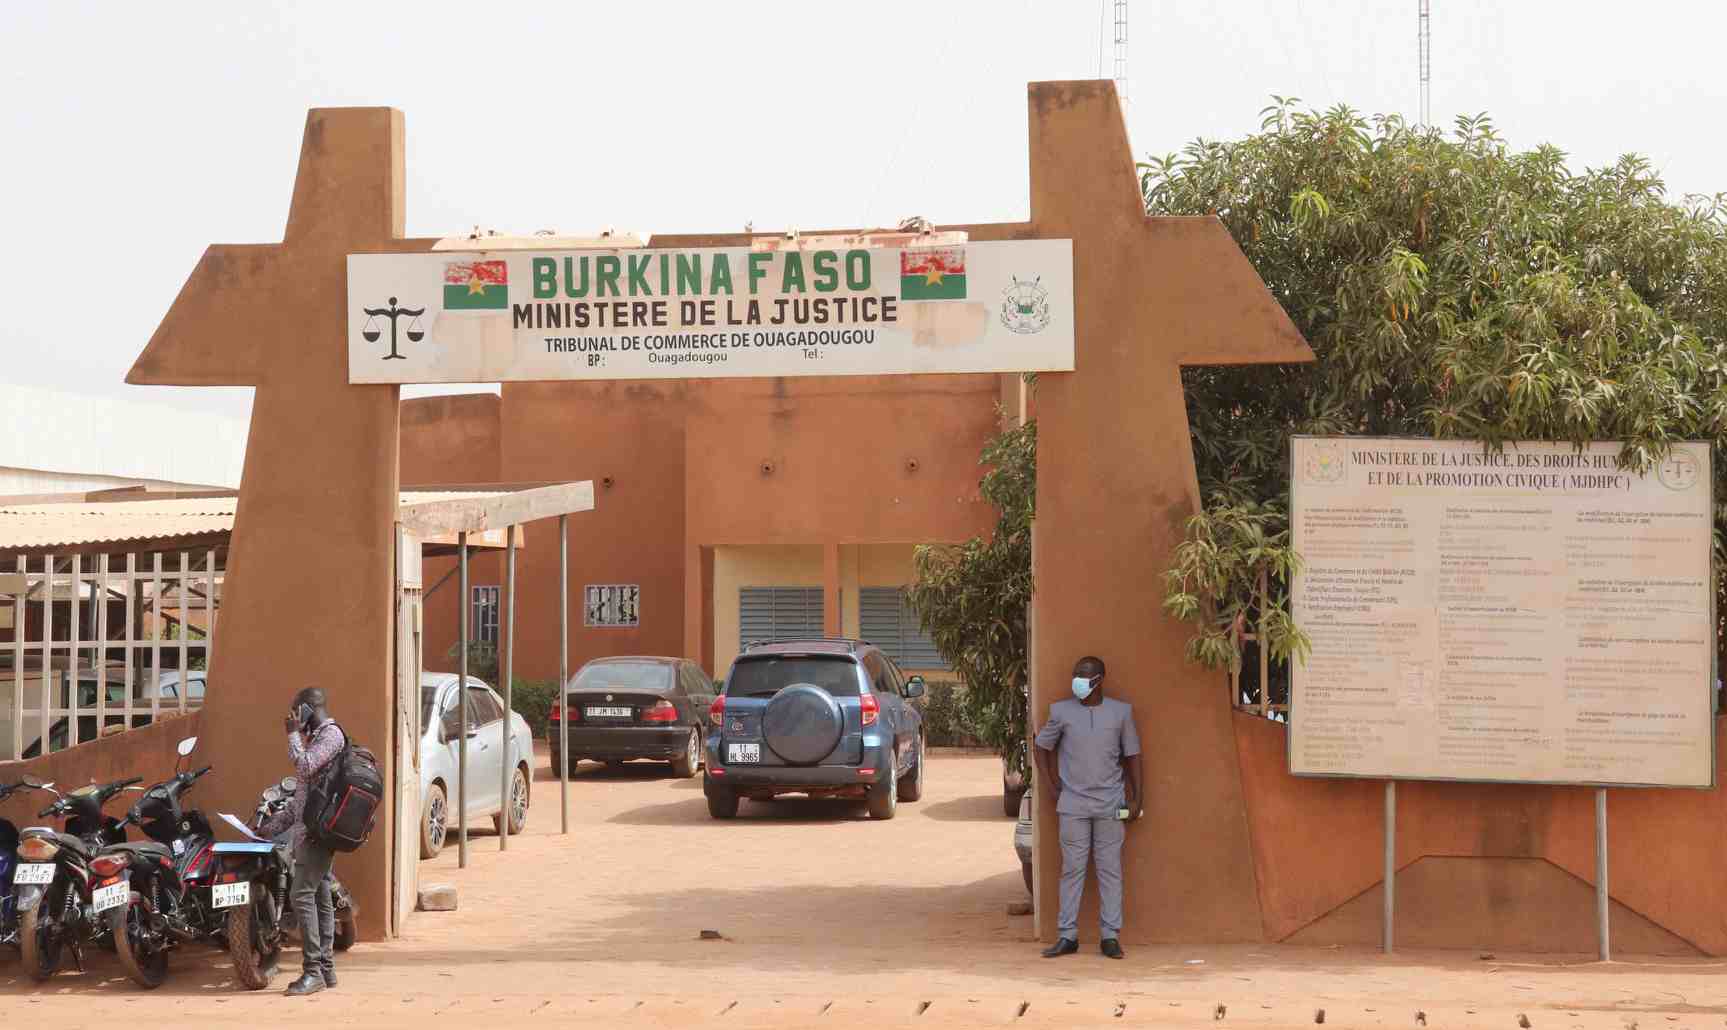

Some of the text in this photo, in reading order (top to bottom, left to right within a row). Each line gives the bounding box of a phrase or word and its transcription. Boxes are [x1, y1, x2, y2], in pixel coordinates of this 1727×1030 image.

[533, 250, 871, 299] BURKINA FASO
[513, 296, 897, 329] MINISTERE DE LA JUSTICE
[545, 329, 874, 352] TRIBUNAL DE COMMERCE DE OUAGADOUGOU
[649, 352, 728, 365] Ouagadougou
[1351, 451, 1418, 466] MINISTERE
[1422, 452, 1439, 466] DE
[1442, 452, 1457, 467] LA
[1517, 454, 1540, 468] DES
[1543, 454, 1589, 469] DROITS
[1368, 471, 1383, 485] ET
[1387, 472, 1401, 486] DE
[1407, 472, 1422, 486] LA
[1426, 472, 1501, 487] PROMOTION
[1506, 474, 1560, 489] CIVIQUE
